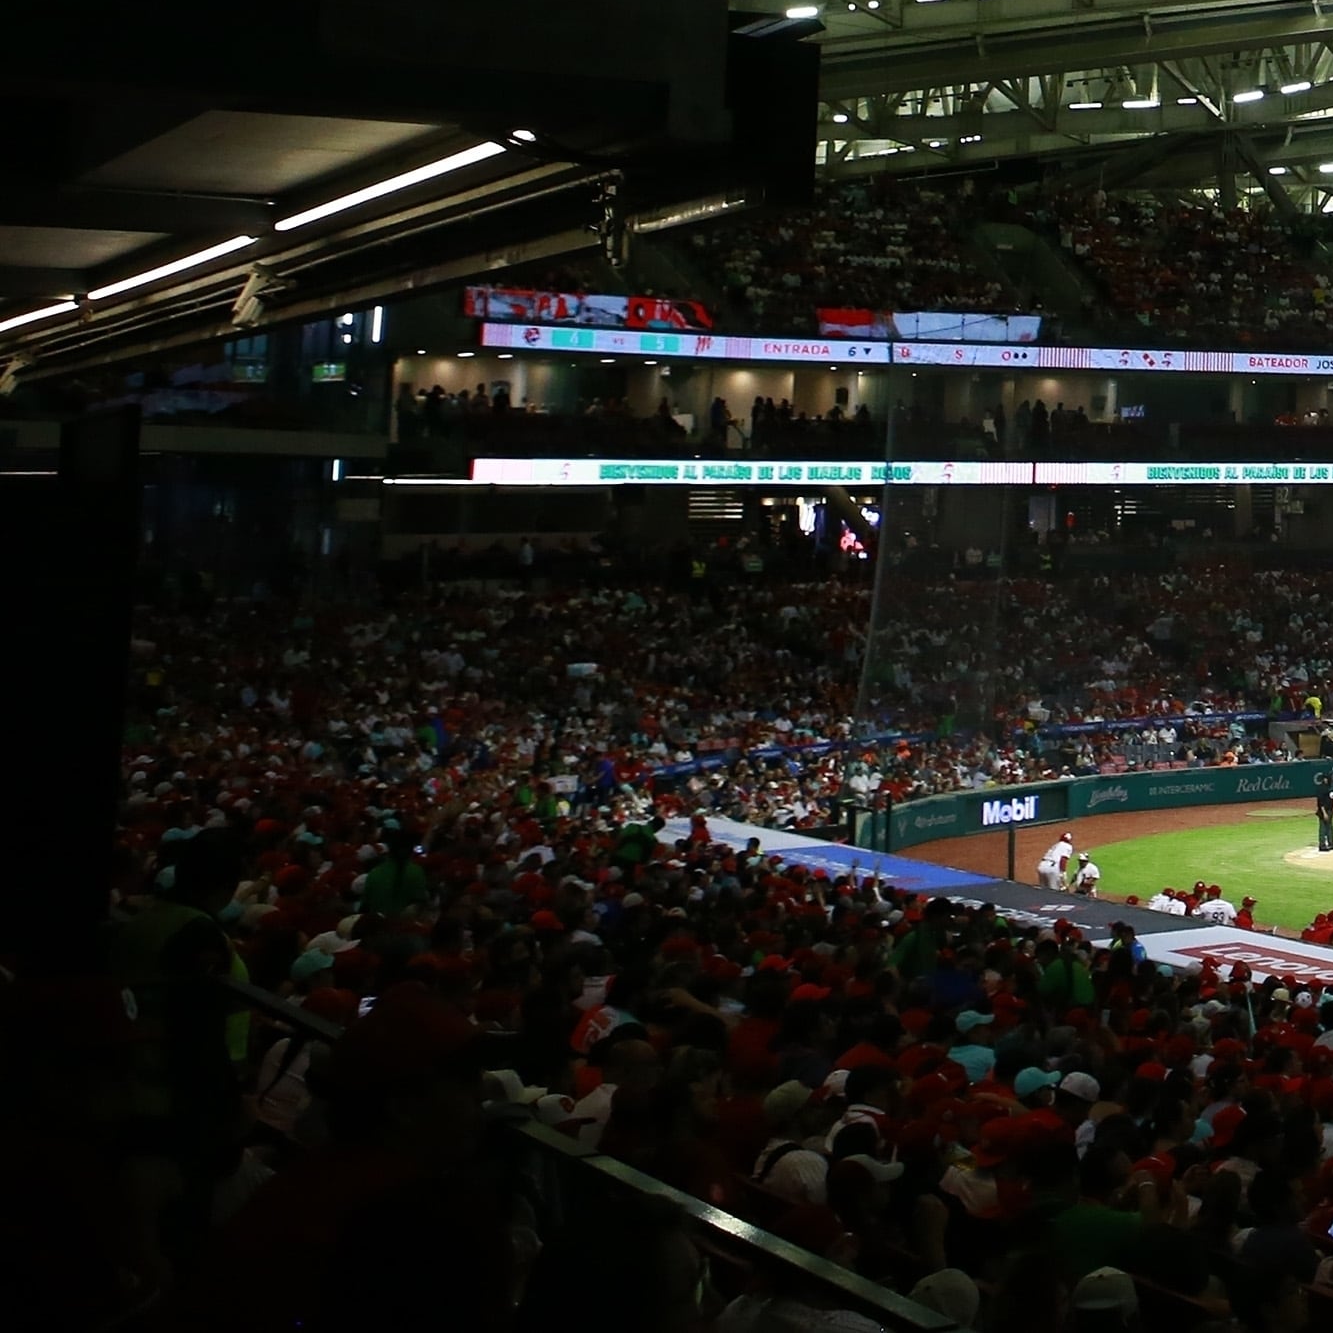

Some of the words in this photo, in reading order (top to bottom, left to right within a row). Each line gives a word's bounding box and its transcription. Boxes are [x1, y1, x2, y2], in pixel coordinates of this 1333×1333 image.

[763, 343, 831, 356] ENTRADA
[847, 346, 857, 357] 6
[954, 349, 964, 360] S
[1248, 356, 1309, 370] BATEADOR
[1146, 466, 1221, 480] BIENVENIDOS
[1224, 467, 1239, 480] AL
[1293, 467, 1307, 480] DE
[1310, 467, 1330, 480] LOS
[1158, 781, 1216, 796] INTERCERAMIC
[1236, 777, 1262, 794] Red
[1263, 774, 1291, 791] Cola
[982, 796, 1038, 827] Mobil
[1211, 911, 1226, 923] 93
